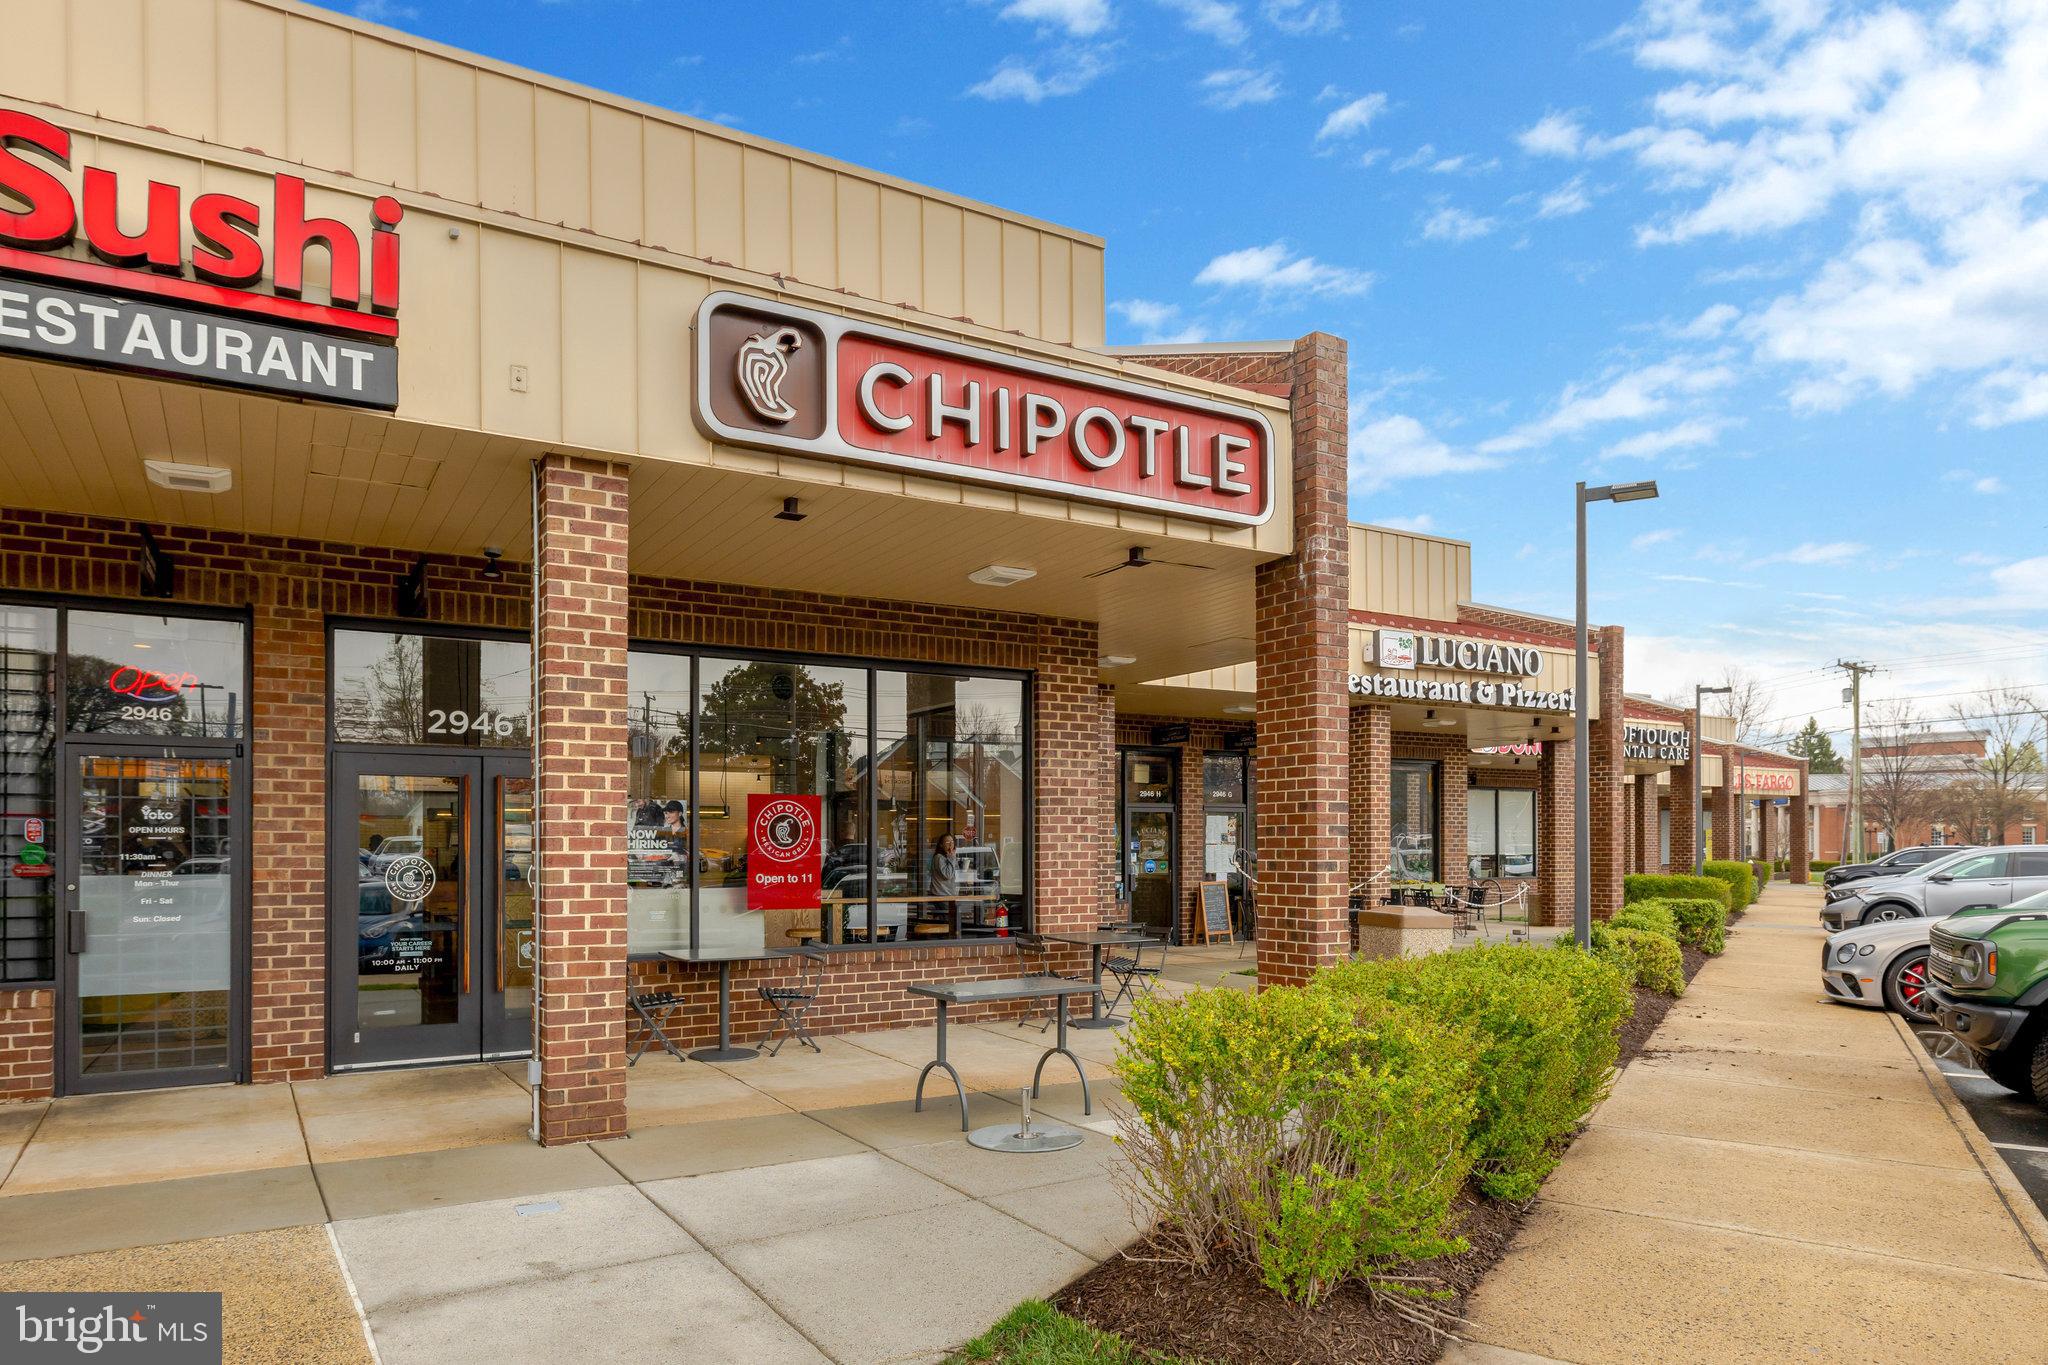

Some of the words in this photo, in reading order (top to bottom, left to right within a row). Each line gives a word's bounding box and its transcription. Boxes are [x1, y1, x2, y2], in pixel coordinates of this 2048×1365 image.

[0, 109, 403, 312] Sushi
[0, 291, 374, 390] ESTAURANT
[857, 362, 1251, 496] CHIPOTLE
[1421, 636, 1544, 676] LUCIANO
[109, 665, 199, 697] Open
[1348, 673, 1470, 702] estaurant
[1476, 681, 1495, 704] &
[1501, 682, 1576, 711] Pizzeri
[121, 705, 173, 721] 2946
[181, 708, 192, 722] J
[427, 709, 514, 736] 2946
[1623, 745, 1654, 759] NTAL
[1660, 747, 1691, 760] CARE
[1756, 774, 1794, 790] FARGO
[141, 805, 174, 820] Yoko
[760, 804, 811, 828] CHIPOTLE
[129, 826, 154, 834] OPEN
[154, 826, 185, 834] HOURS
[628, 829, 657, 840] NOW
[628, 839, 668, 849] HIRING
[761, 836, 791, 857] MEXICAN
[792, 837, 810, 856] GRILL
[120, 853, 156, 861] 11:30am
[390, 858, 433, 876] CHIPOTLE
[755, 873, 785, 885] Open
[787, 873, 799, 883] to
[801, 873, 813, 883] 11
[159, 897, 174, 905] Sat
[153, 915, 182, 923] Closed
[394, 964, 420, 972] DAILY
